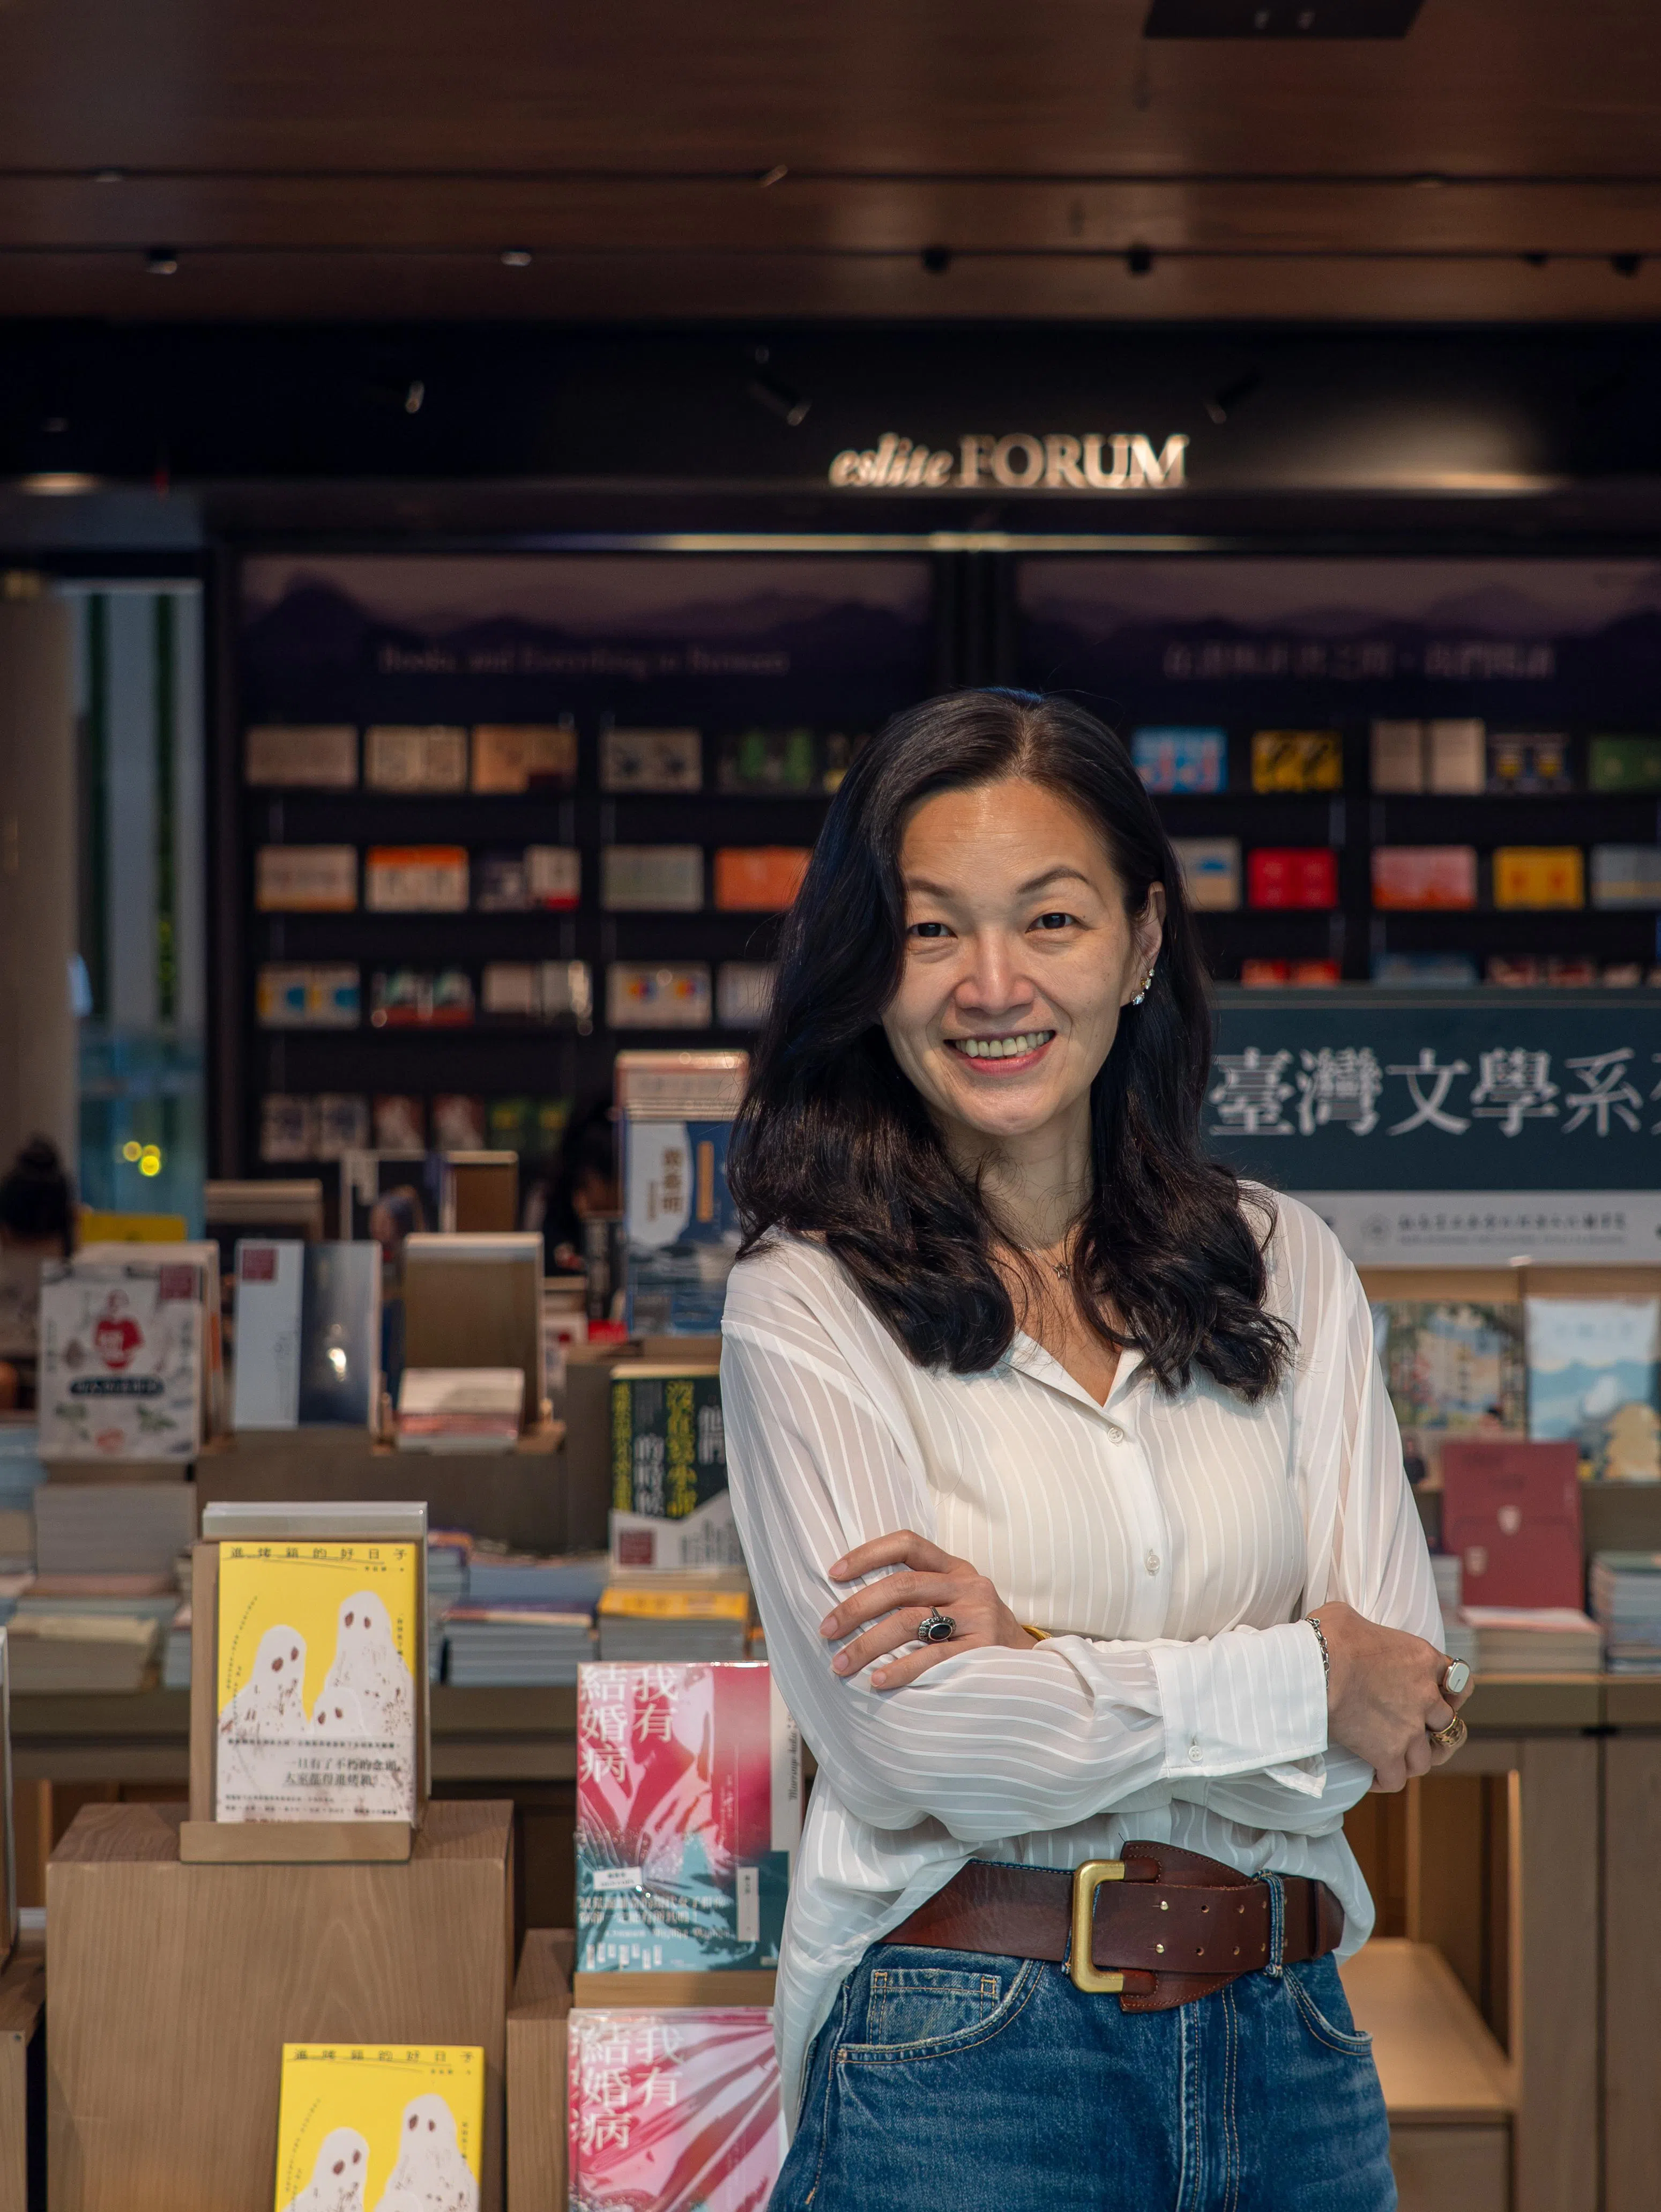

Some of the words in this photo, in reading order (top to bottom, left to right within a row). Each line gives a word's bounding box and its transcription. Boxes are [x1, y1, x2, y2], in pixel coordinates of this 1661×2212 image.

[829, 432, 954, 487] eslite
[955, 433, 1190, 489] FORUM
[1209, 1046, 1661, 1137] 臺灣文學系
[579, 1665, 628, 1783] 結婚病
[633, 1665, 680, 1743] 我有
[579, 2021, 632, 2156] 結婚病
[635, 2019, 685, 2107] 我有
